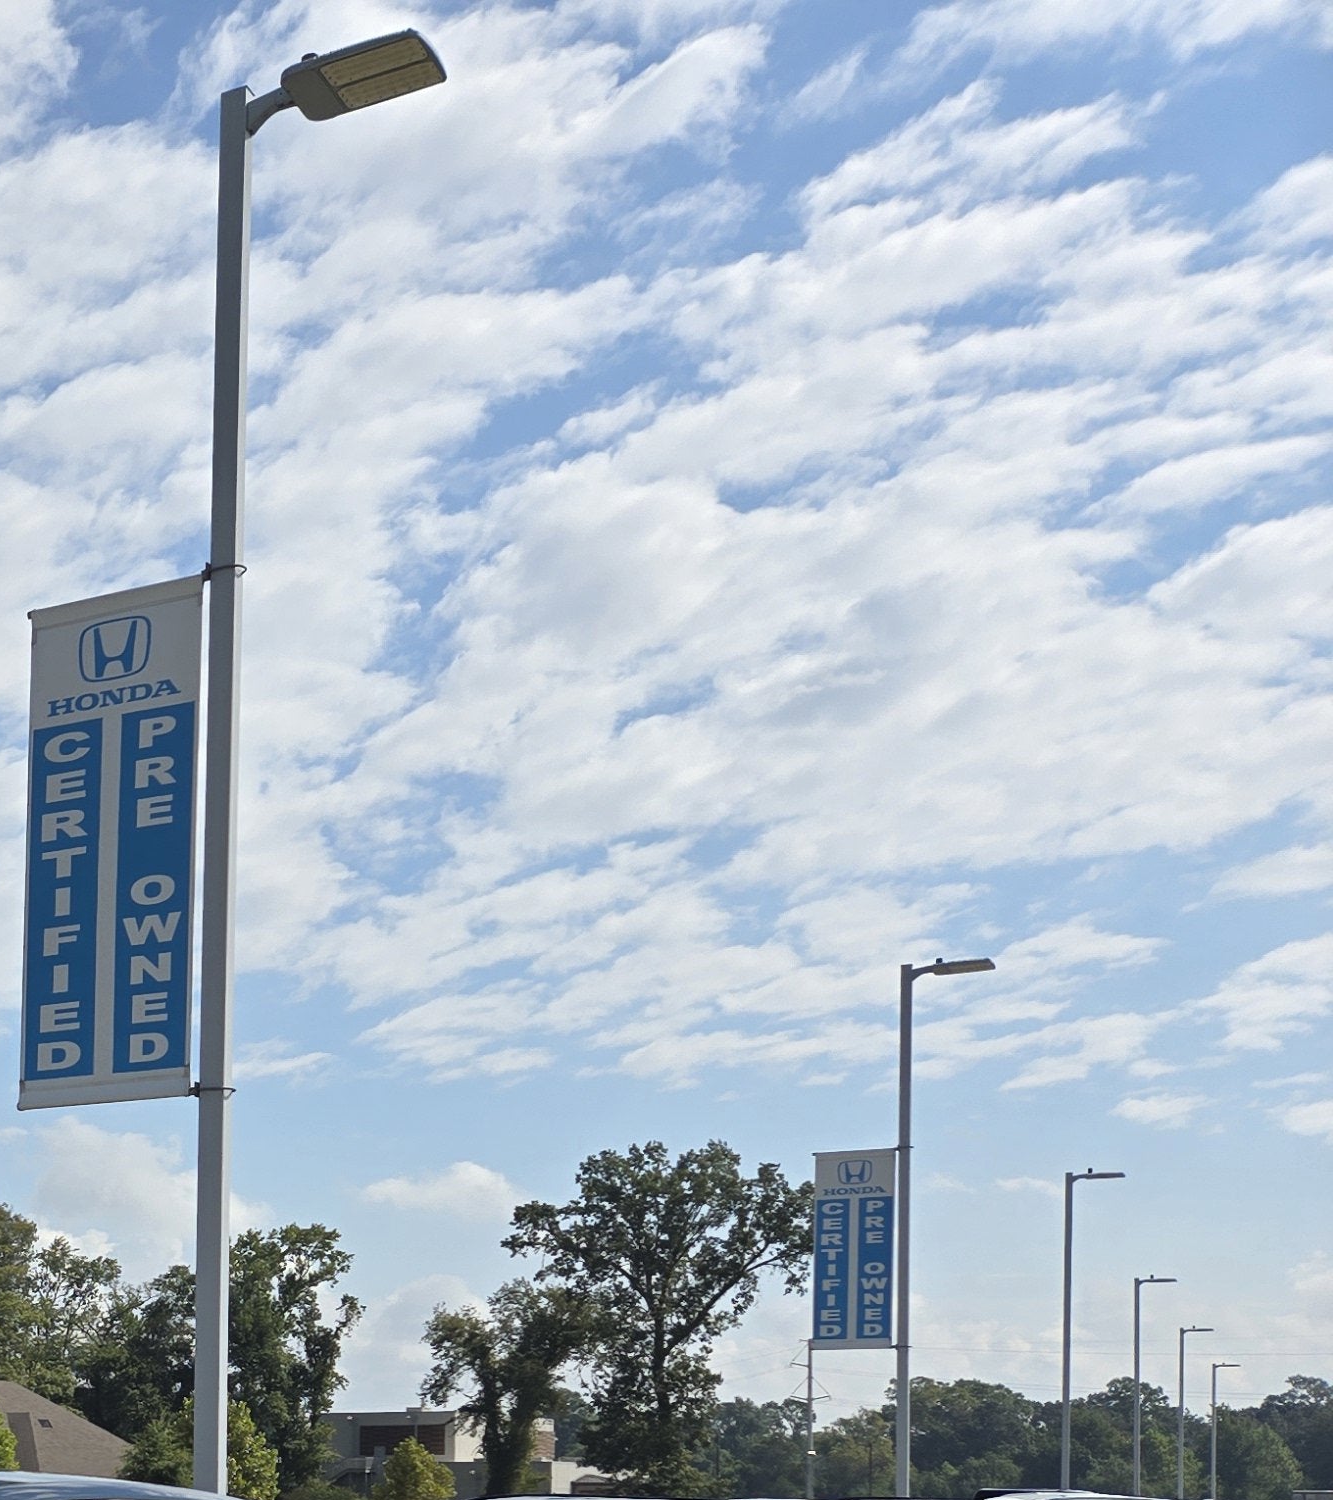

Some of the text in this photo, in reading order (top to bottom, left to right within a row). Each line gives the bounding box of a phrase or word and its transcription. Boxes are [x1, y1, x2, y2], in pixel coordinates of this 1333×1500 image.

[47, 678, 181, 717] HONDA
[36, 731, 91, 1072] CERTIFIED
[122, 715, 181, 1064] PRE OWNED
[823, 1186, 886, 1196] HONDA
[819, 1202, 844, 1337] CERTIFIED
[860, 1200, 887, 1336] PRE OWNED
